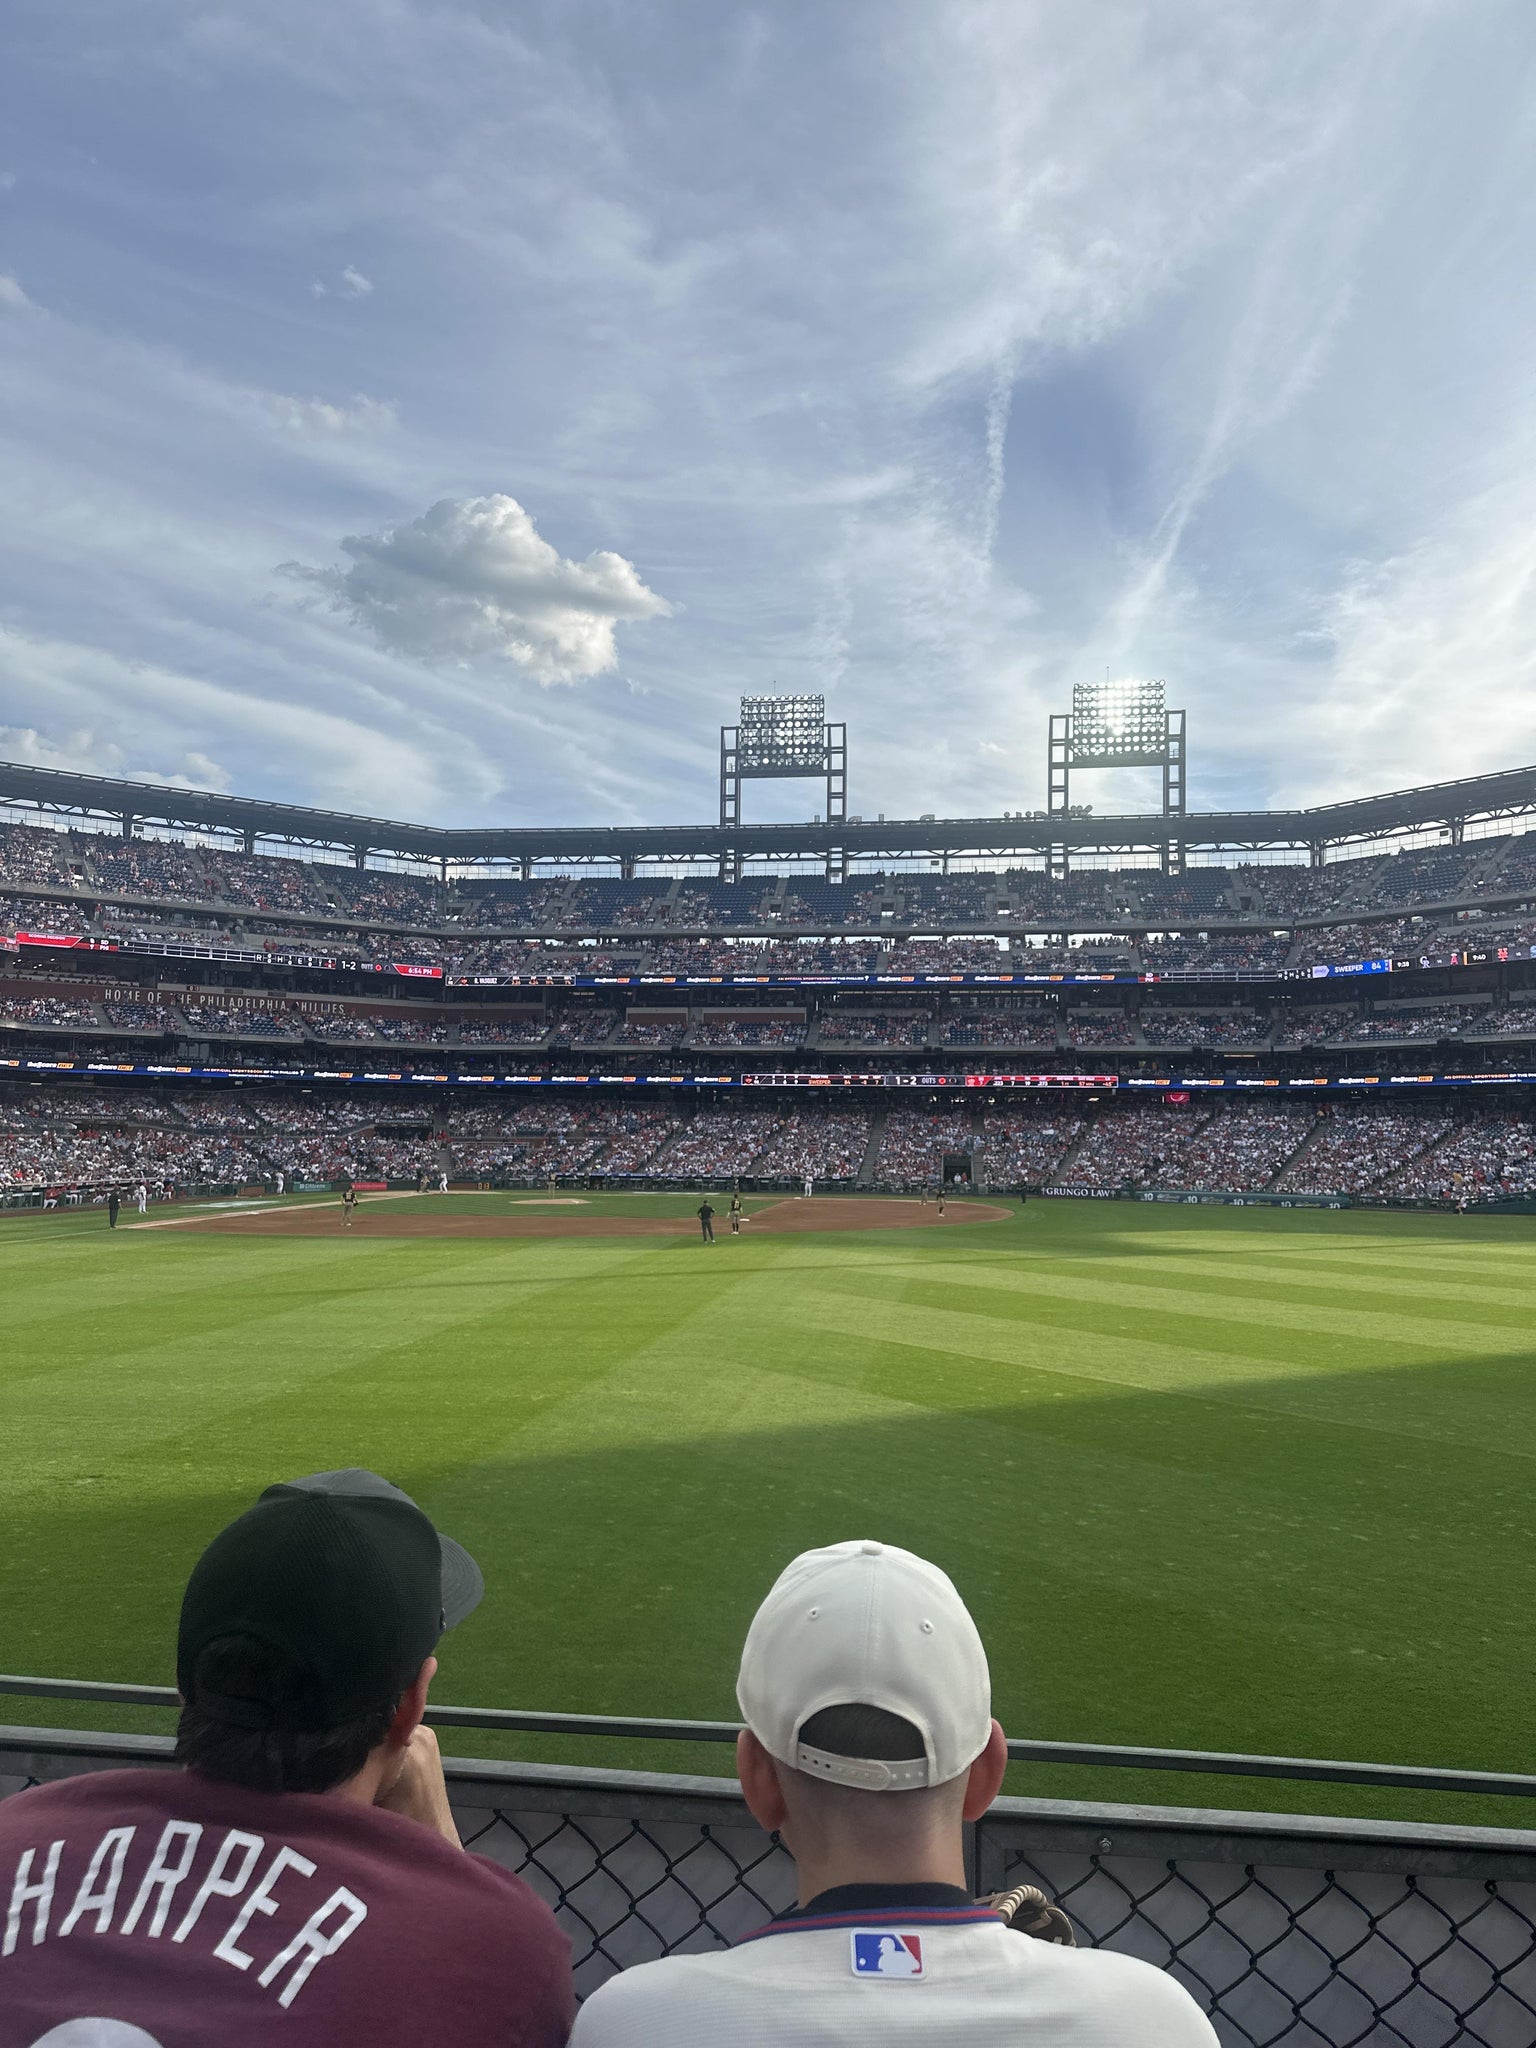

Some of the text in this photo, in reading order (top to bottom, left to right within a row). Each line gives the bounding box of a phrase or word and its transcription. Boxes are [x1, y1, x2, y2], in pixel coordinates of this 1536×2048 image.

[341, 961, 356, 971] 1-2
[1334, 964, 1364, 974] SWEEPER
[1371, 962, 1382, 970] 84
[147, 991, 161, 1003] OF
[200, 995, 286, 1011] PHILADELPHIA
[1046, 1188, 1110, 1197] GRUNGO LAW
[2, 1820, 368, 2010] HARPER
